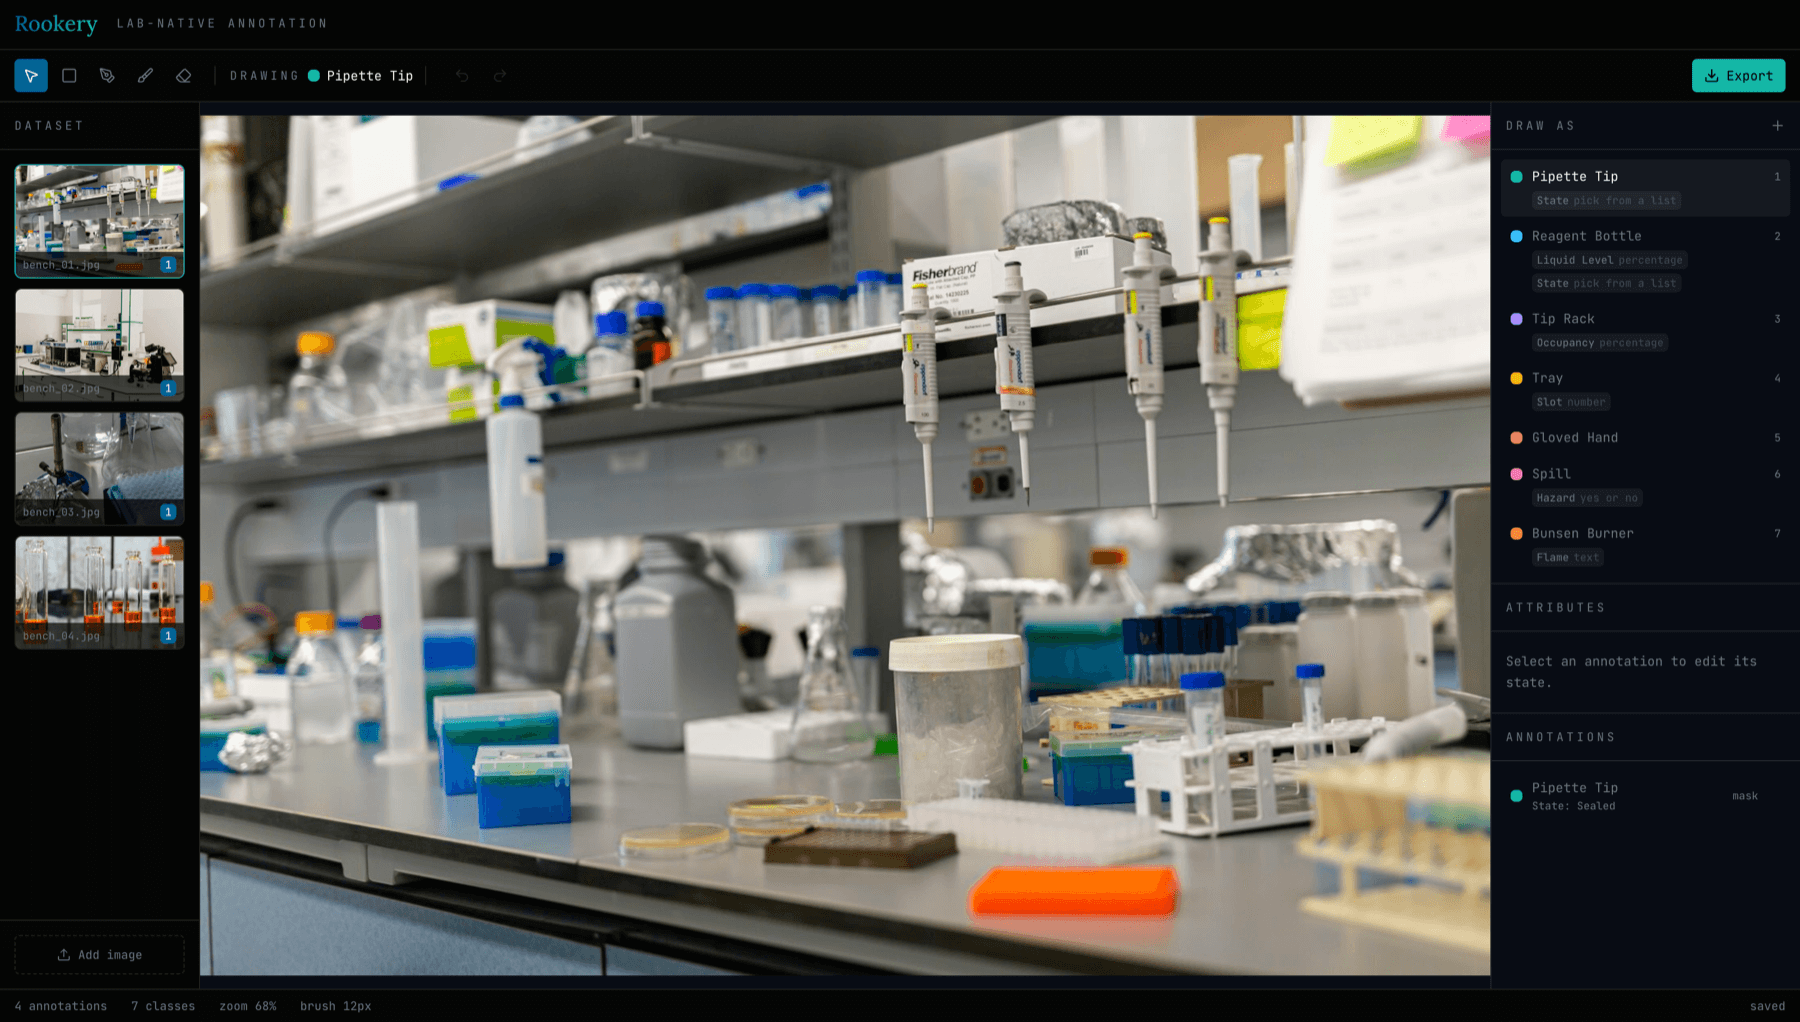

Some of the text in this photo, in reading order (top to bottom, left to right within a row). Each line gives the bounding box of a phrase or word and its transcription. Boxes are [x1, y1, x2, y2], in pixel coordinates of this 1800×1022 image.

[15, 14, 99, 38] Rookery
[117, 17, 326, 29] LAB-NATIVE ANNOTATION
[230, 70, 298, 81] DRAWING
[327, 69, 414, 84] Pipette Tip
[1726, 69, 1774, 84] Export
[14, 120, 83, 131] DATASET
[1506, 120, 1574, 131] DRAW AS
[1532, 170, 1619, 185] Pipette Tip
[1774, 171, 1781, 182] 1
[1536, 195, 1676, 207] State pick from a list
[1532, 230, 1642, 244] Reagent Bottle
[1774, 231, 1781, 241] 2
[23, 260, 100, 271] bench_01.jpg
[165, 260, 172, 269] 1
[1537, 254, 1683, 267] Liquid Level percentage
[912, 261, 977, 281] Fisherbrand
[1536, 277, 1677, 290] State pick from a list
[1532, 312, 1595, 327] Tip Rack
[1774, 313, 1781, 324] 3
[1536, 337, 1664, 350] Occupancy percentage
[1015, 350, 1024, 383] eppendorf
[920, 364, 928, 396] eppendorf
[1532, 371, 1564, 386] Tray
[1774, 373, 1781, 383] 4
[23, 384, 100, 395] bench_02.jpg
[165, 384, 172, 393] 1
[1536, 396, 1606, 407] Slot number
[1532, 431, 1618, 443] Gloved Hand
[1774, 432, 1781, 443] 5
[1532, 467, 1572, 482] Spill
[1774, 469, 1781, 479] 6
[1536, 492, 1638, 505] Hazard yes or no
[23, 508, 100, 519] bench_03.jpg
[165, 508, 172, 517] 1
[1532, 527, 1634, 539] Bunsen Burner
[1774, 528, 1781, 538] 7
[1536, 552, 1599, 563] Flame text
[1505, 601, 1604, 613] ATTRIBUTES
[23, 631, 100, 642] bench_04.jpg
[165, 631, 172, 640] 1
[1506, 654, 1757, 667] Select an annotation to edit its
[1506, 677, 1551, 688] state.
[1505, 731, 1614, 742] ANNOTATIONS
[1532, 781, 1619, 796] Pipette Tip
[1732, 790, 1758, 801] mask
[1532, 800, 1616, 811] State: Sealed
[78, 948, 143, 962] Add image
[14, 1000, 108, 1011] 4 annotations
[131, 1000, 196, 1012] 7 classes
[219, 1000, 277, 1011] zoom 68%
[300, 1000, 372, 1013] brush 12px
[1750, 1000, 1786, 1012] saved
